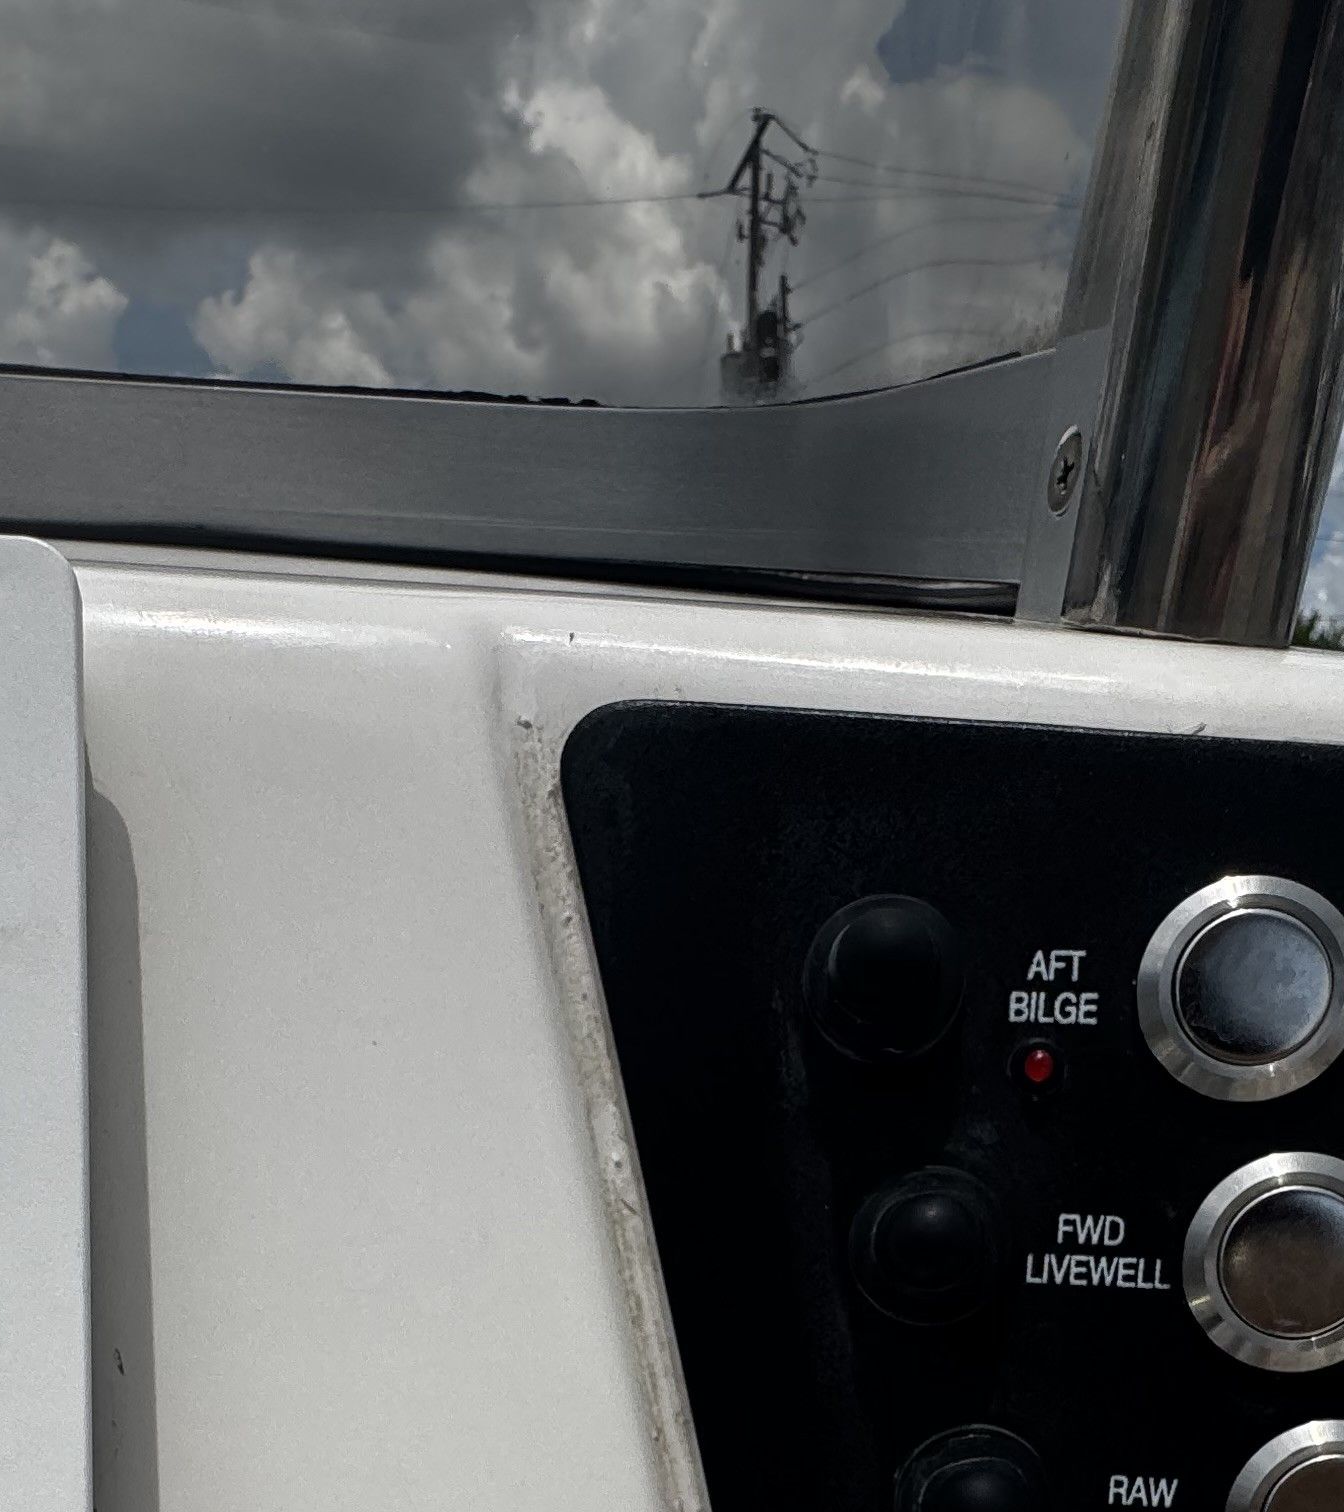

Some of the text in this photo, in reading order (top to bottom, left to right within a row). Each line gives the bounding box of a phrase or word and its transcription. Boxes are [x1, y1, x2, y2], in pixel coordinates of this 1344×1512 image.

[1026, 949, 1087, 982] AFT
[1008, 990, 1099, 1026] BILGE
[1056, 1213, 1125, 1246] FWD
[1025, 1253, 1171, 1290] LIVEWELL
[1108, 1474, 1178, 1508] RAW
